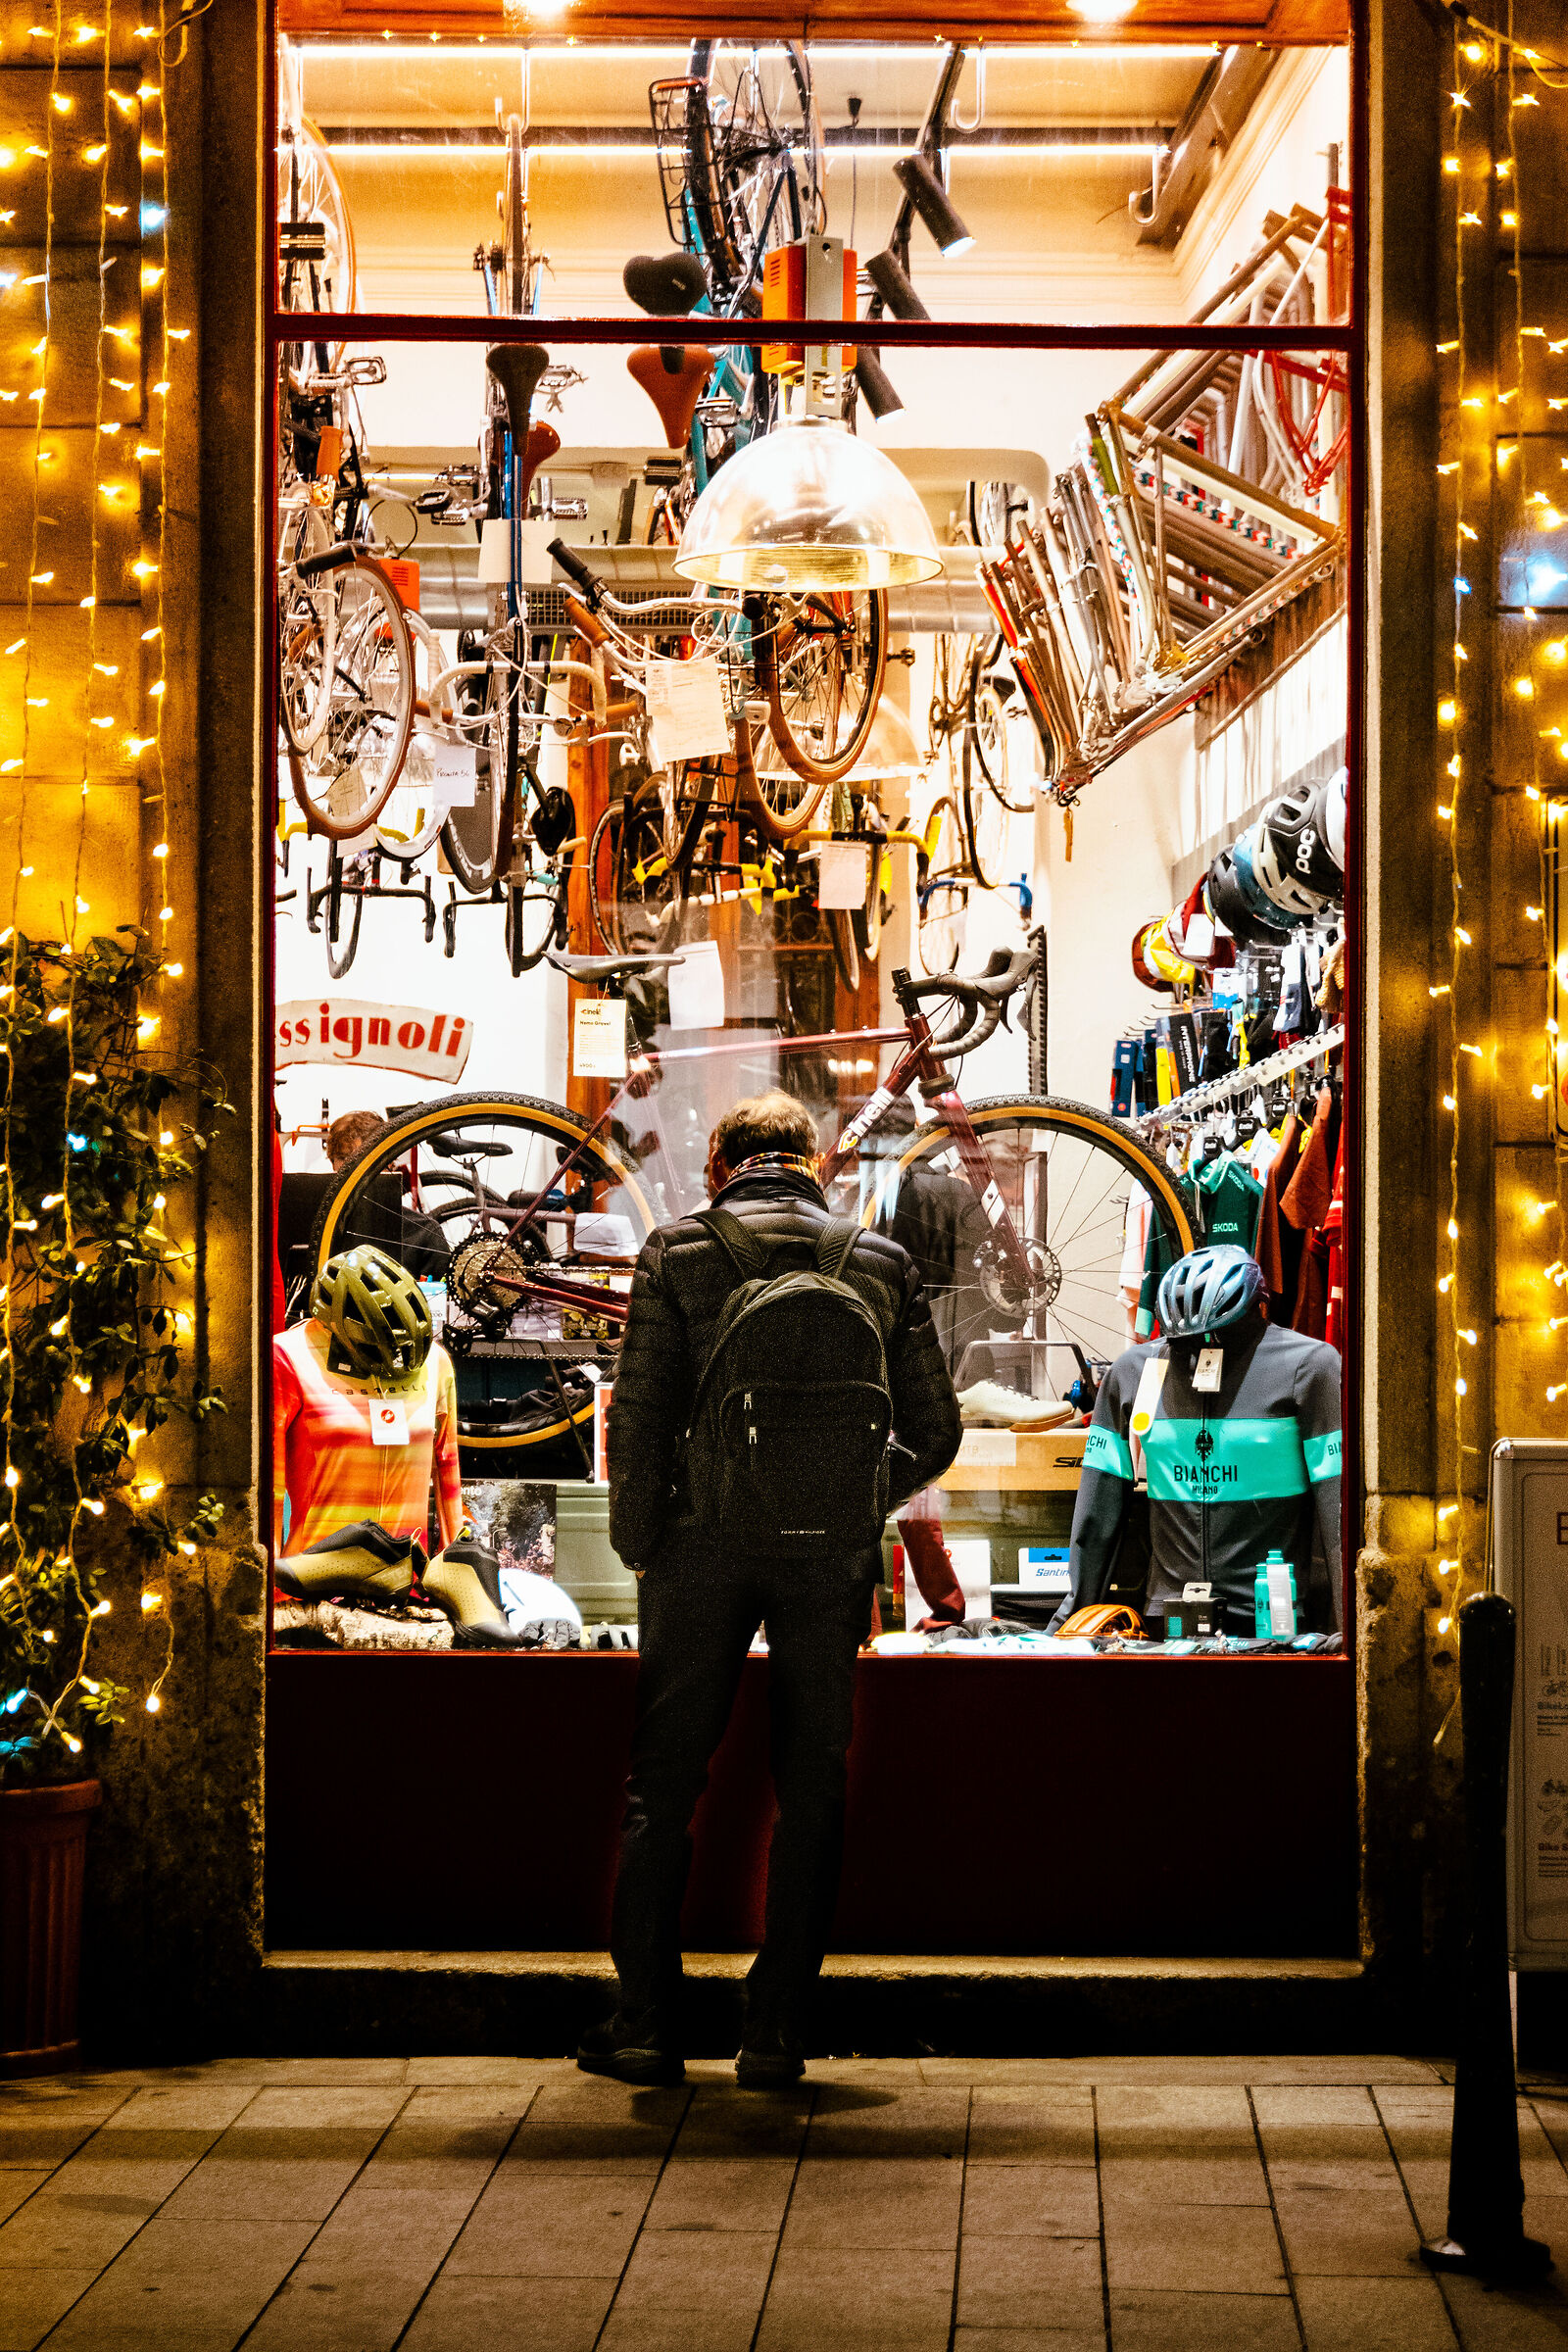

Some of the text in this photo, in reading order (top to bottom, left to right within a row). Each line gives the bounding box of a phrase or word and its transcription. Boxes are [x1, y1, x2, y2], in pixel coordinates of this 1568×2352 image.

[278, 1002, 466, 1059] ssignoli
[1180, 1025, 1196, 1083] INTERPHONE
[1212, 1222, 1239, 1233] SKODA
[1174, 1464, 1238, 1483] BIANCHI
[1035, 1567, 1070, 1577] Santin
